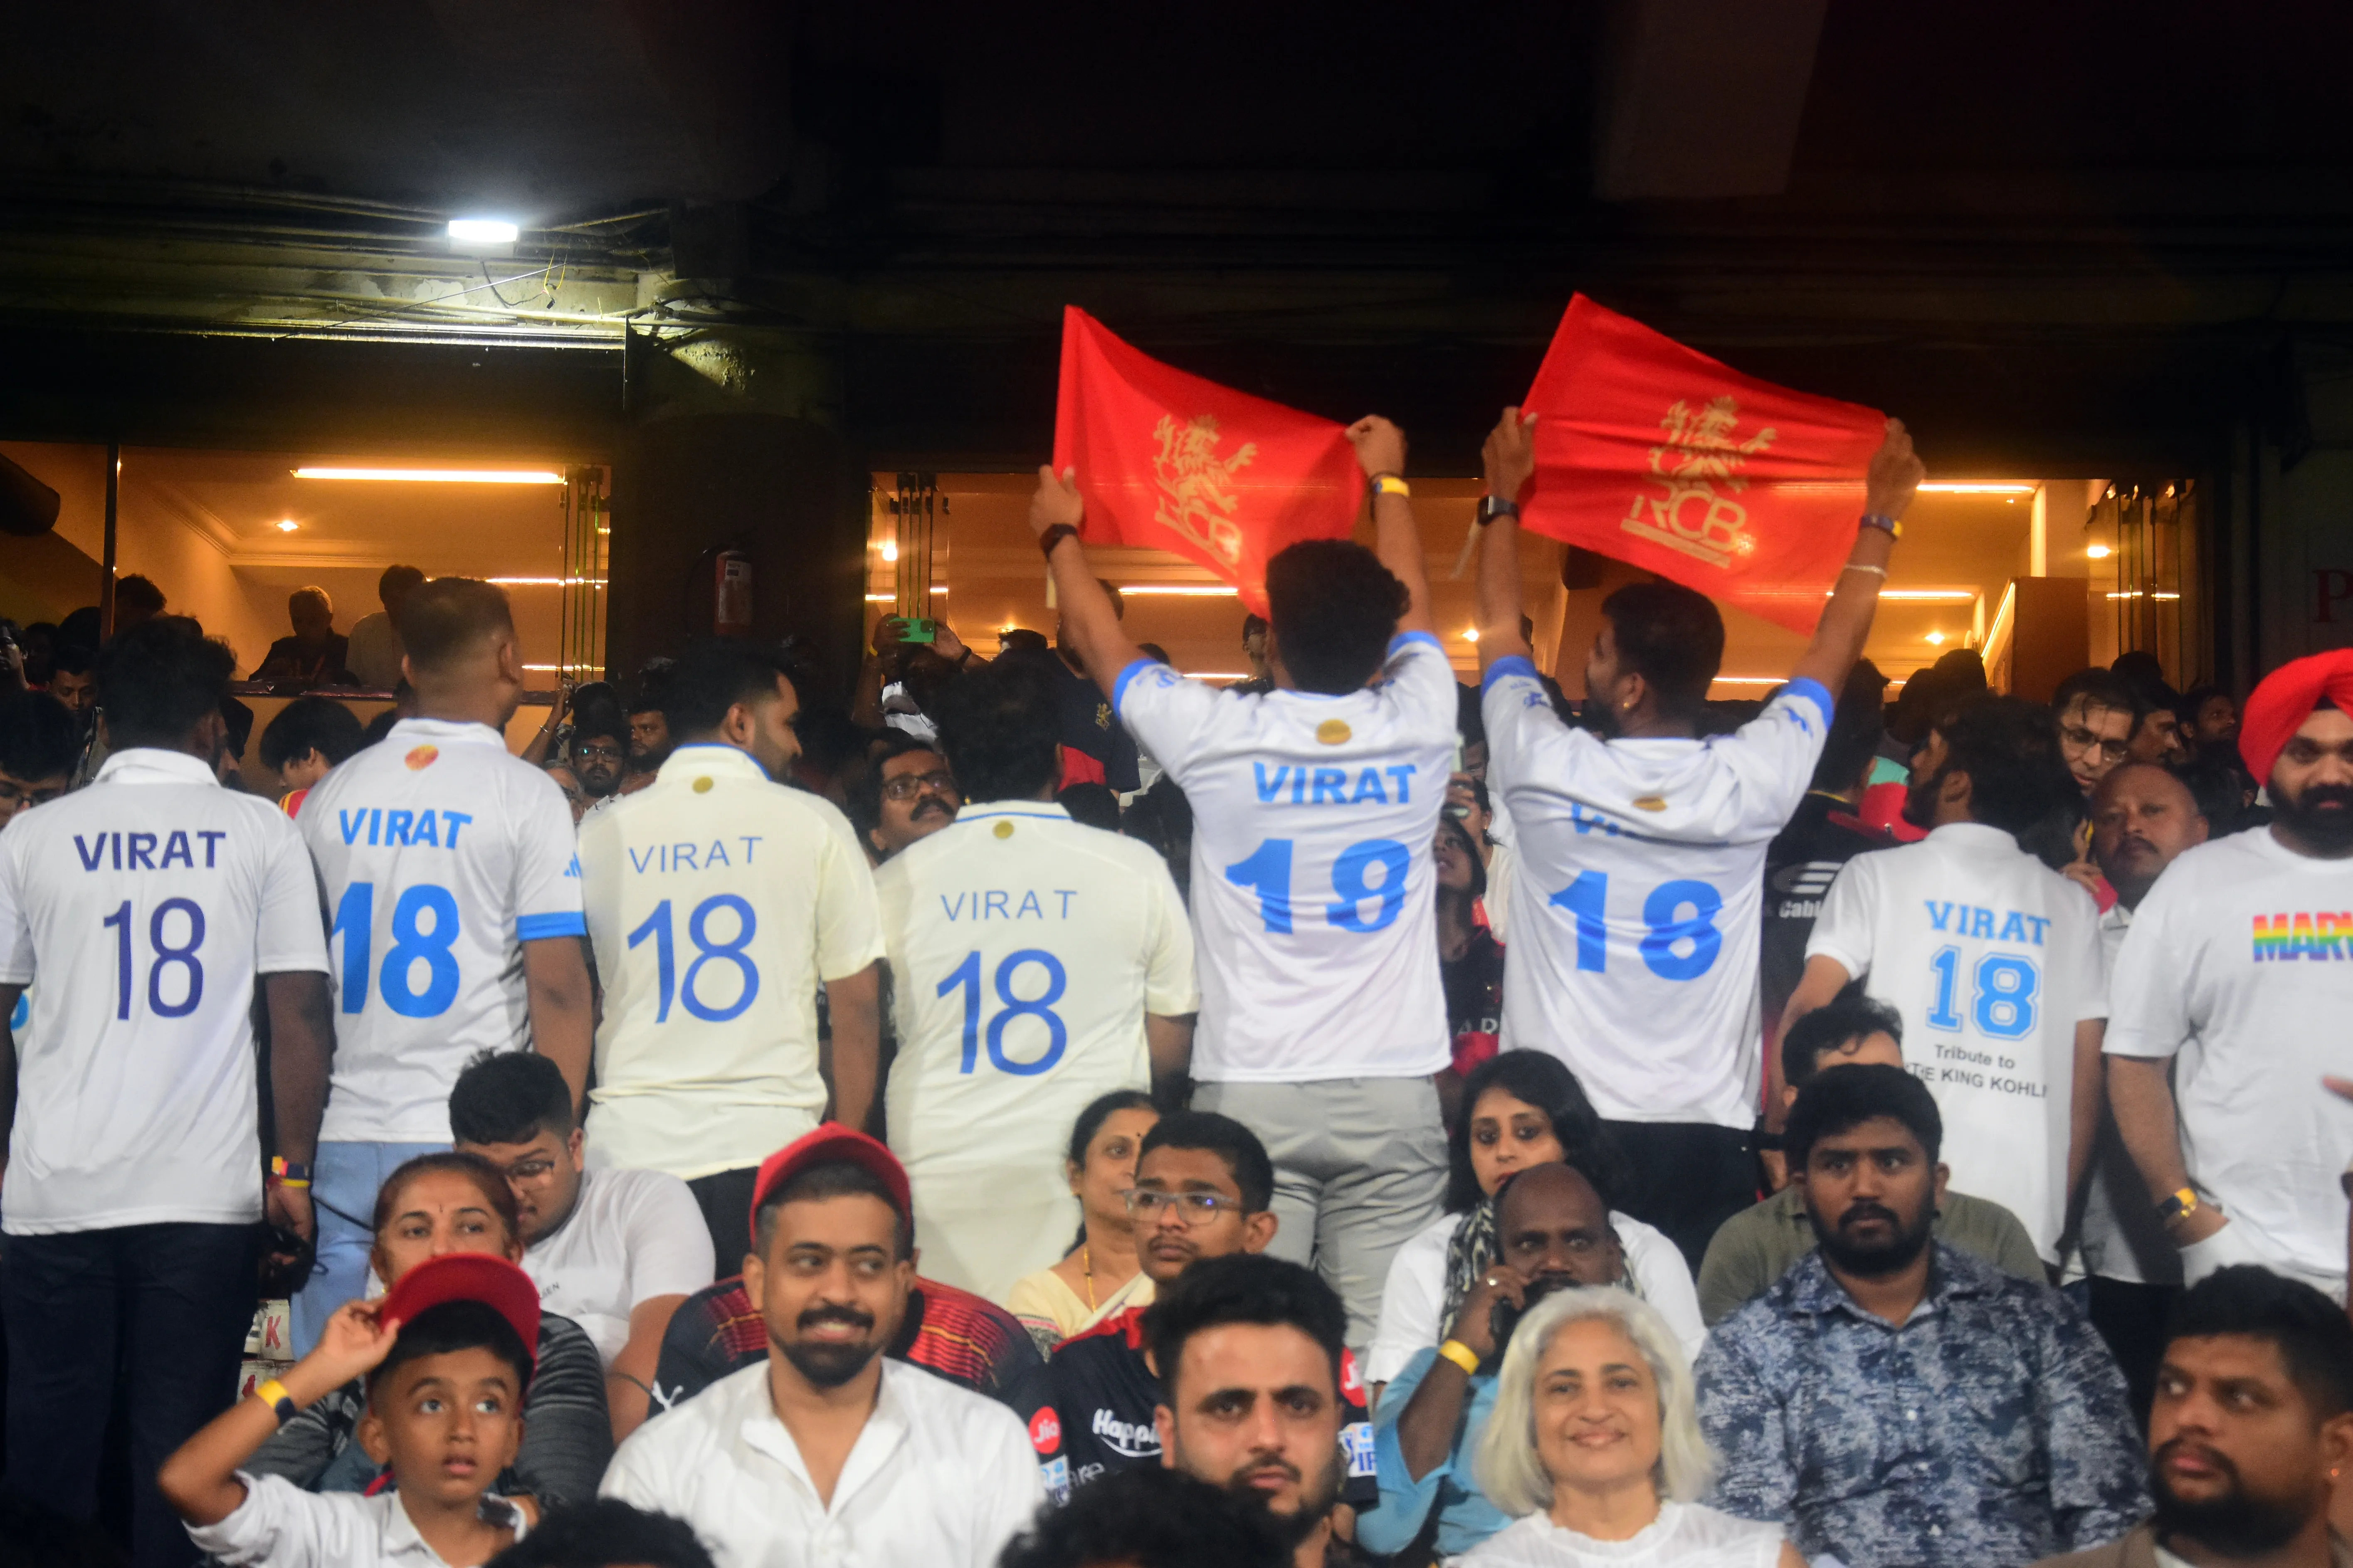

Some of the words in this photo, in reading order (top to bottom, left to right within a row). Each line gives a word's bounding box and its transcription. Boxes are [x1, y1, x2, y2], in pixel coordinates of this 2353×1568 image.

[1252, 761, 1417, 806] VIRAT
[74, 831, 226, 872] VIRAT
[340, 808, 473, 850] VIRAT
[629, 837, 763, 874] VIRAT
[941, 890, 1078, 921] VIRAT
[1224, 838, 1413, 935] 18
[1548, 869, 1723, 981] 18
[1925, 900, 2052, 947] VIRAT
[104, 898, 205, 1021] 18
[333, 881, 461, 1019] 18
[628, 894, 760, 1023] 18
[937, 949, 1068, 1077] 18
[1926, 944, 2042, 1041] 18
[1936, 1043, 1993, 1066] Tribute
[1997, 1055, 2015, 1070] to
[1941, 1068, 1983, 1088] KING
[265, 1315, 281, 1350] K
